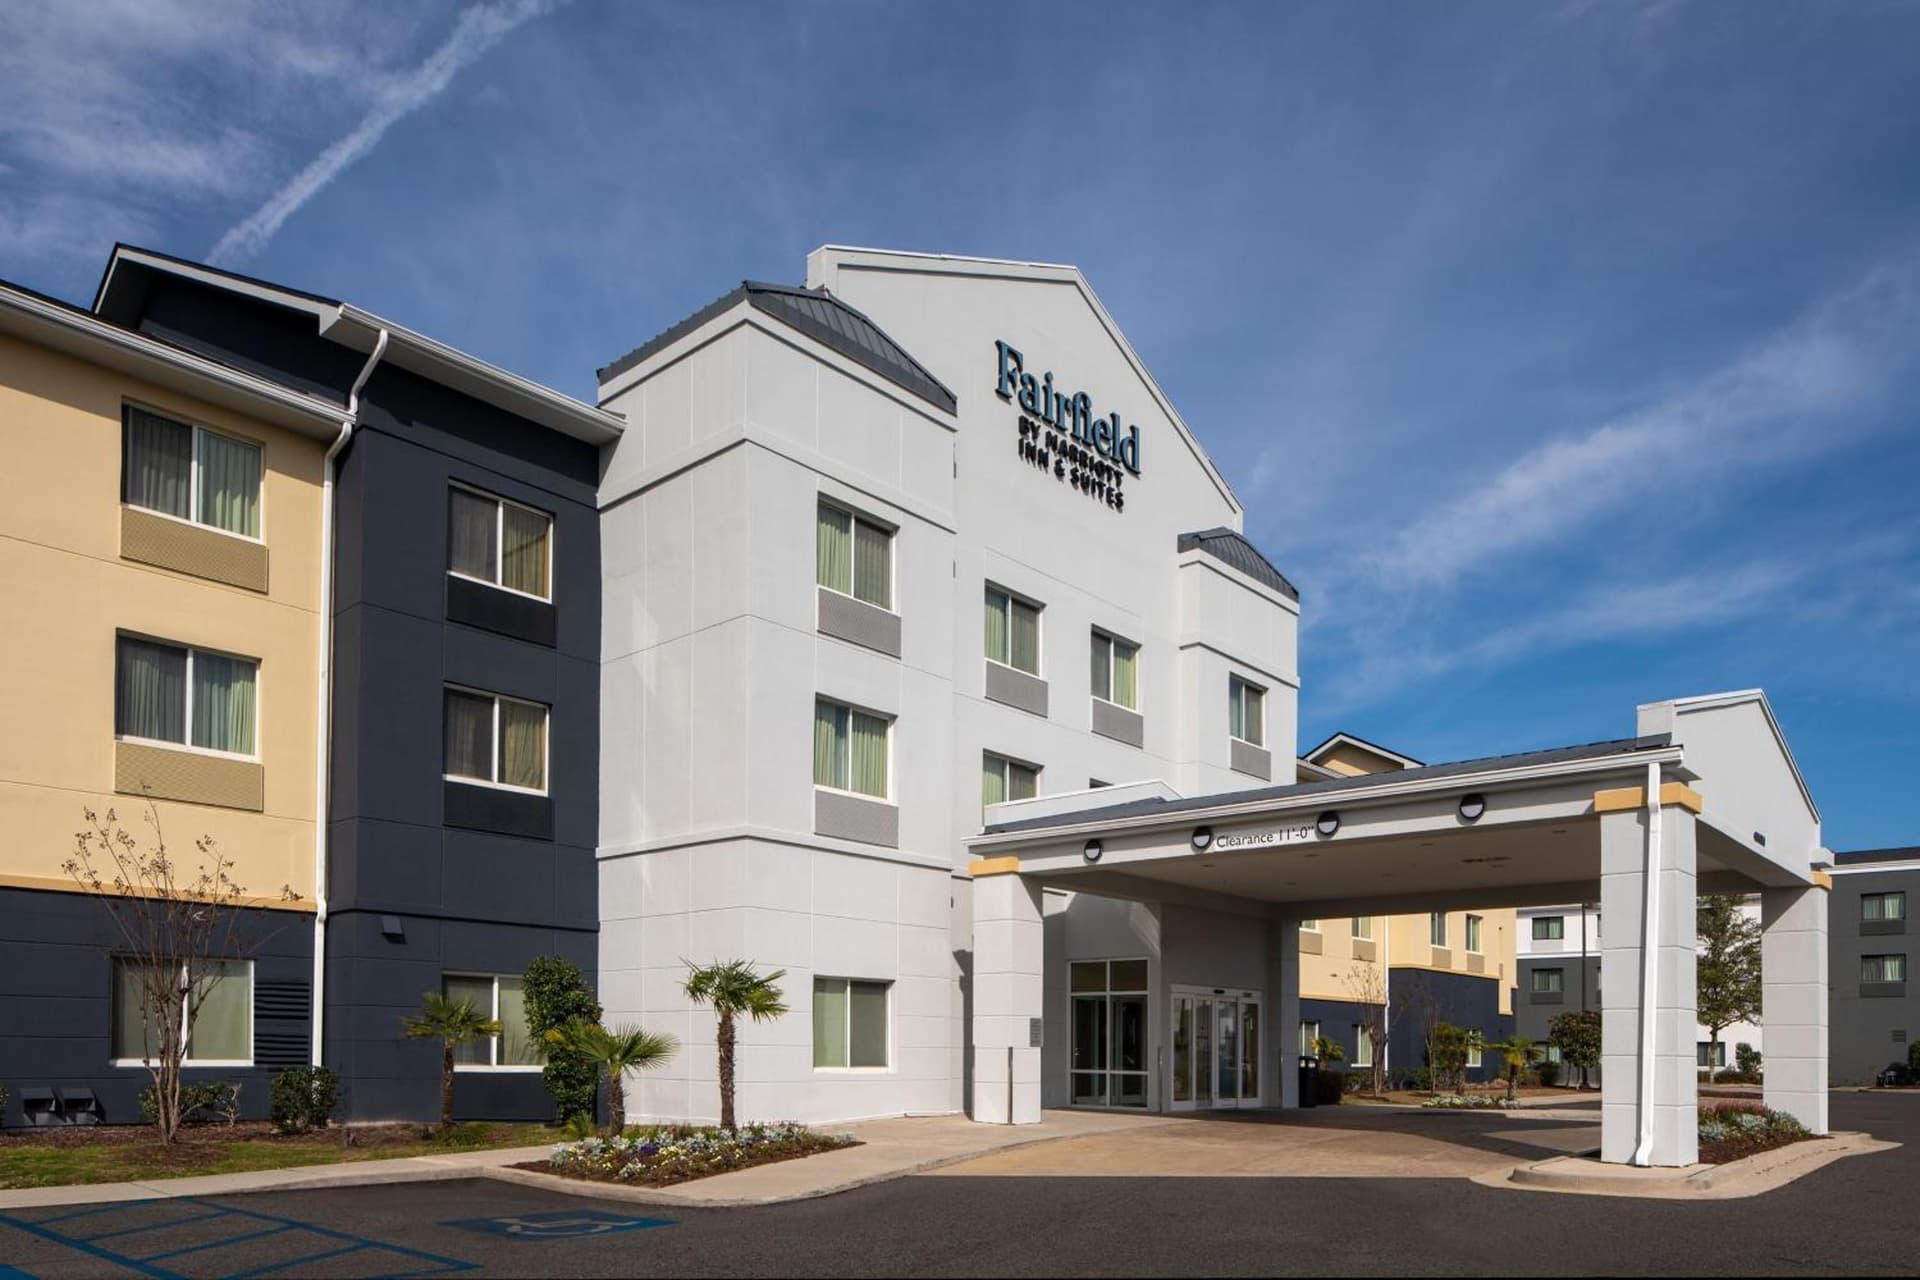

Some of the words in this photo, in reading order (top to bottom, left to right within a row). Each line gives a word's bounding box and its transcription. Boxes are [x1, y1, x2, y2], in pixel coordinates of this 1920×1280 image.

[995, 339, 1141, 475] Fairfield
[1018, 415, 1040, 441] BY
[1045, 430, 1123, 488] MARRIOTT
[1018, 438, 1049, 470] INN
[1054, 458, 1065, 481] &
[1070, 467, 1123, 511] SUITES
[1216, 833, 1274, 848] Clearance
